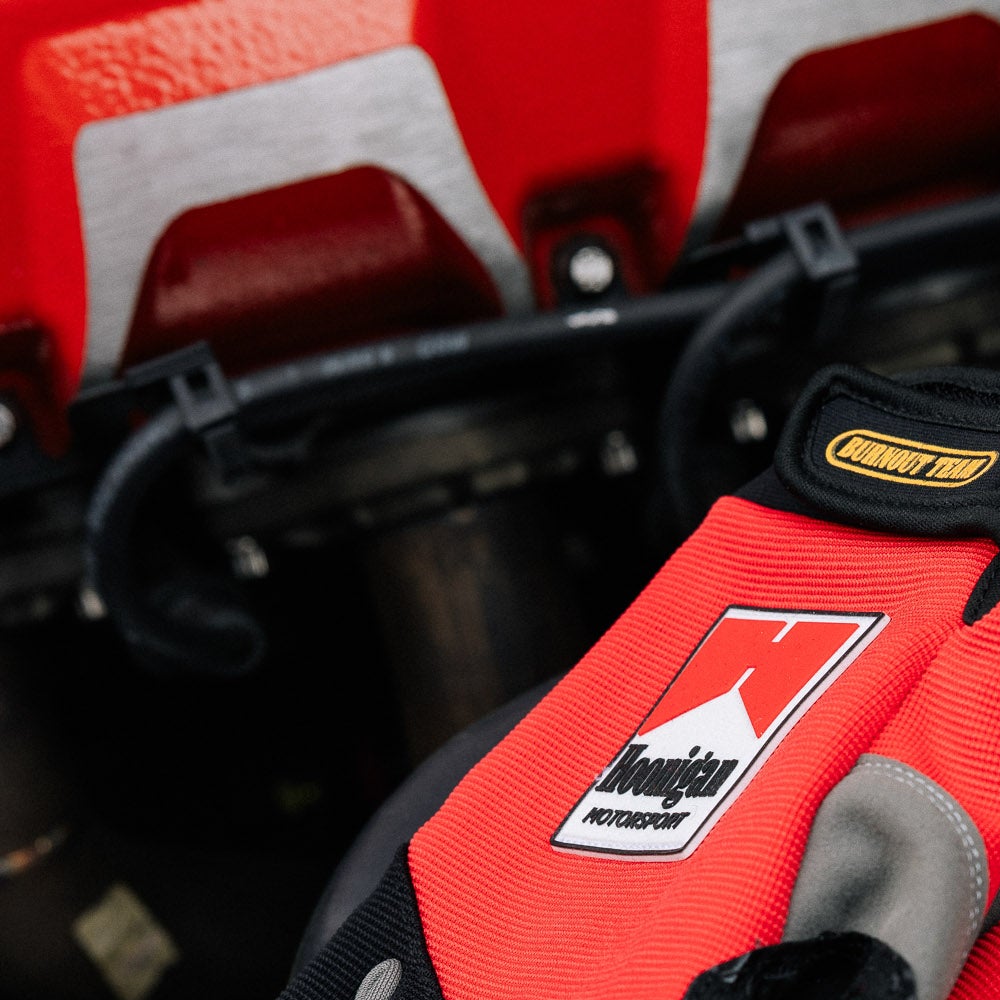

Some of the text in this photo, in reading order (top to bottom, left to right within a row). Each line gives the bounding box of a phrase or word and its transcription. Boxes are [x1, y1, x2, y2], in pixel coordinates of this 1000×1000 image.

[836, 436, 987, 480] BURNOUT TEAM
[594, 743, 739, 809] Hoonigan
[581, 806, 691, 830] MOTORSPORT
